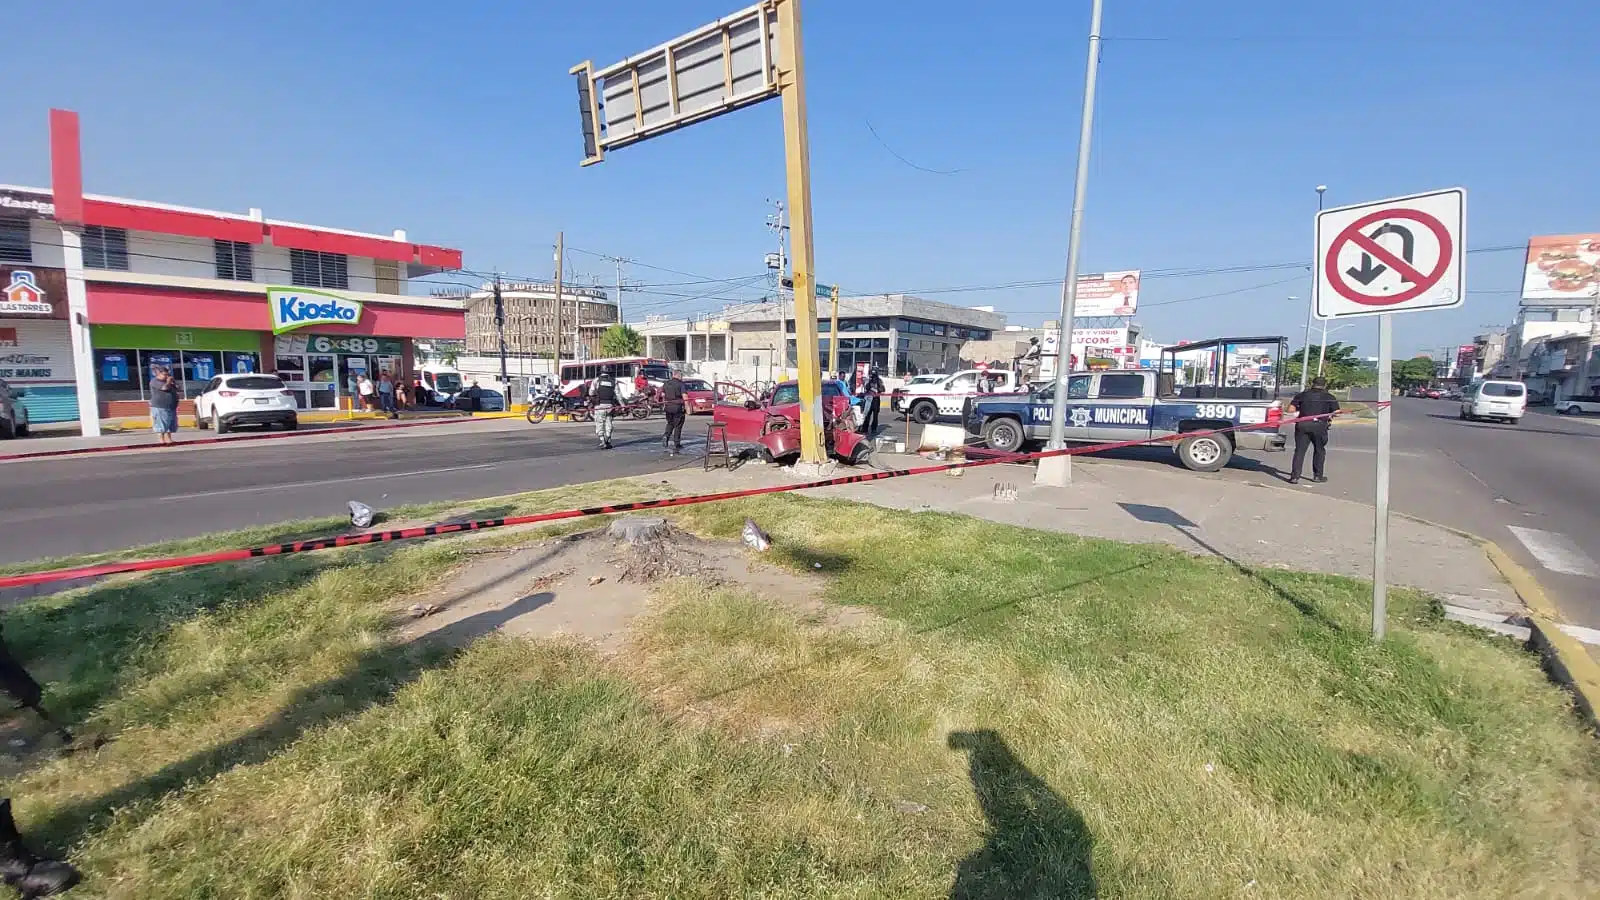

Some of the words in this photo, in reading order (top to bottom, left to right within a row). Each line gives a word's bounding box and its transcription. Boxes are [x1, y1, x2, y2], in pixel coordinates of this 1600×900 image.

[280, 297, 355, 323] Kiosko
[1033, 407, 1067, 421] POLI
[1094, 408, 1149, 424] MUNICIPAL
[1196, 404, 1236, 419] 3890
